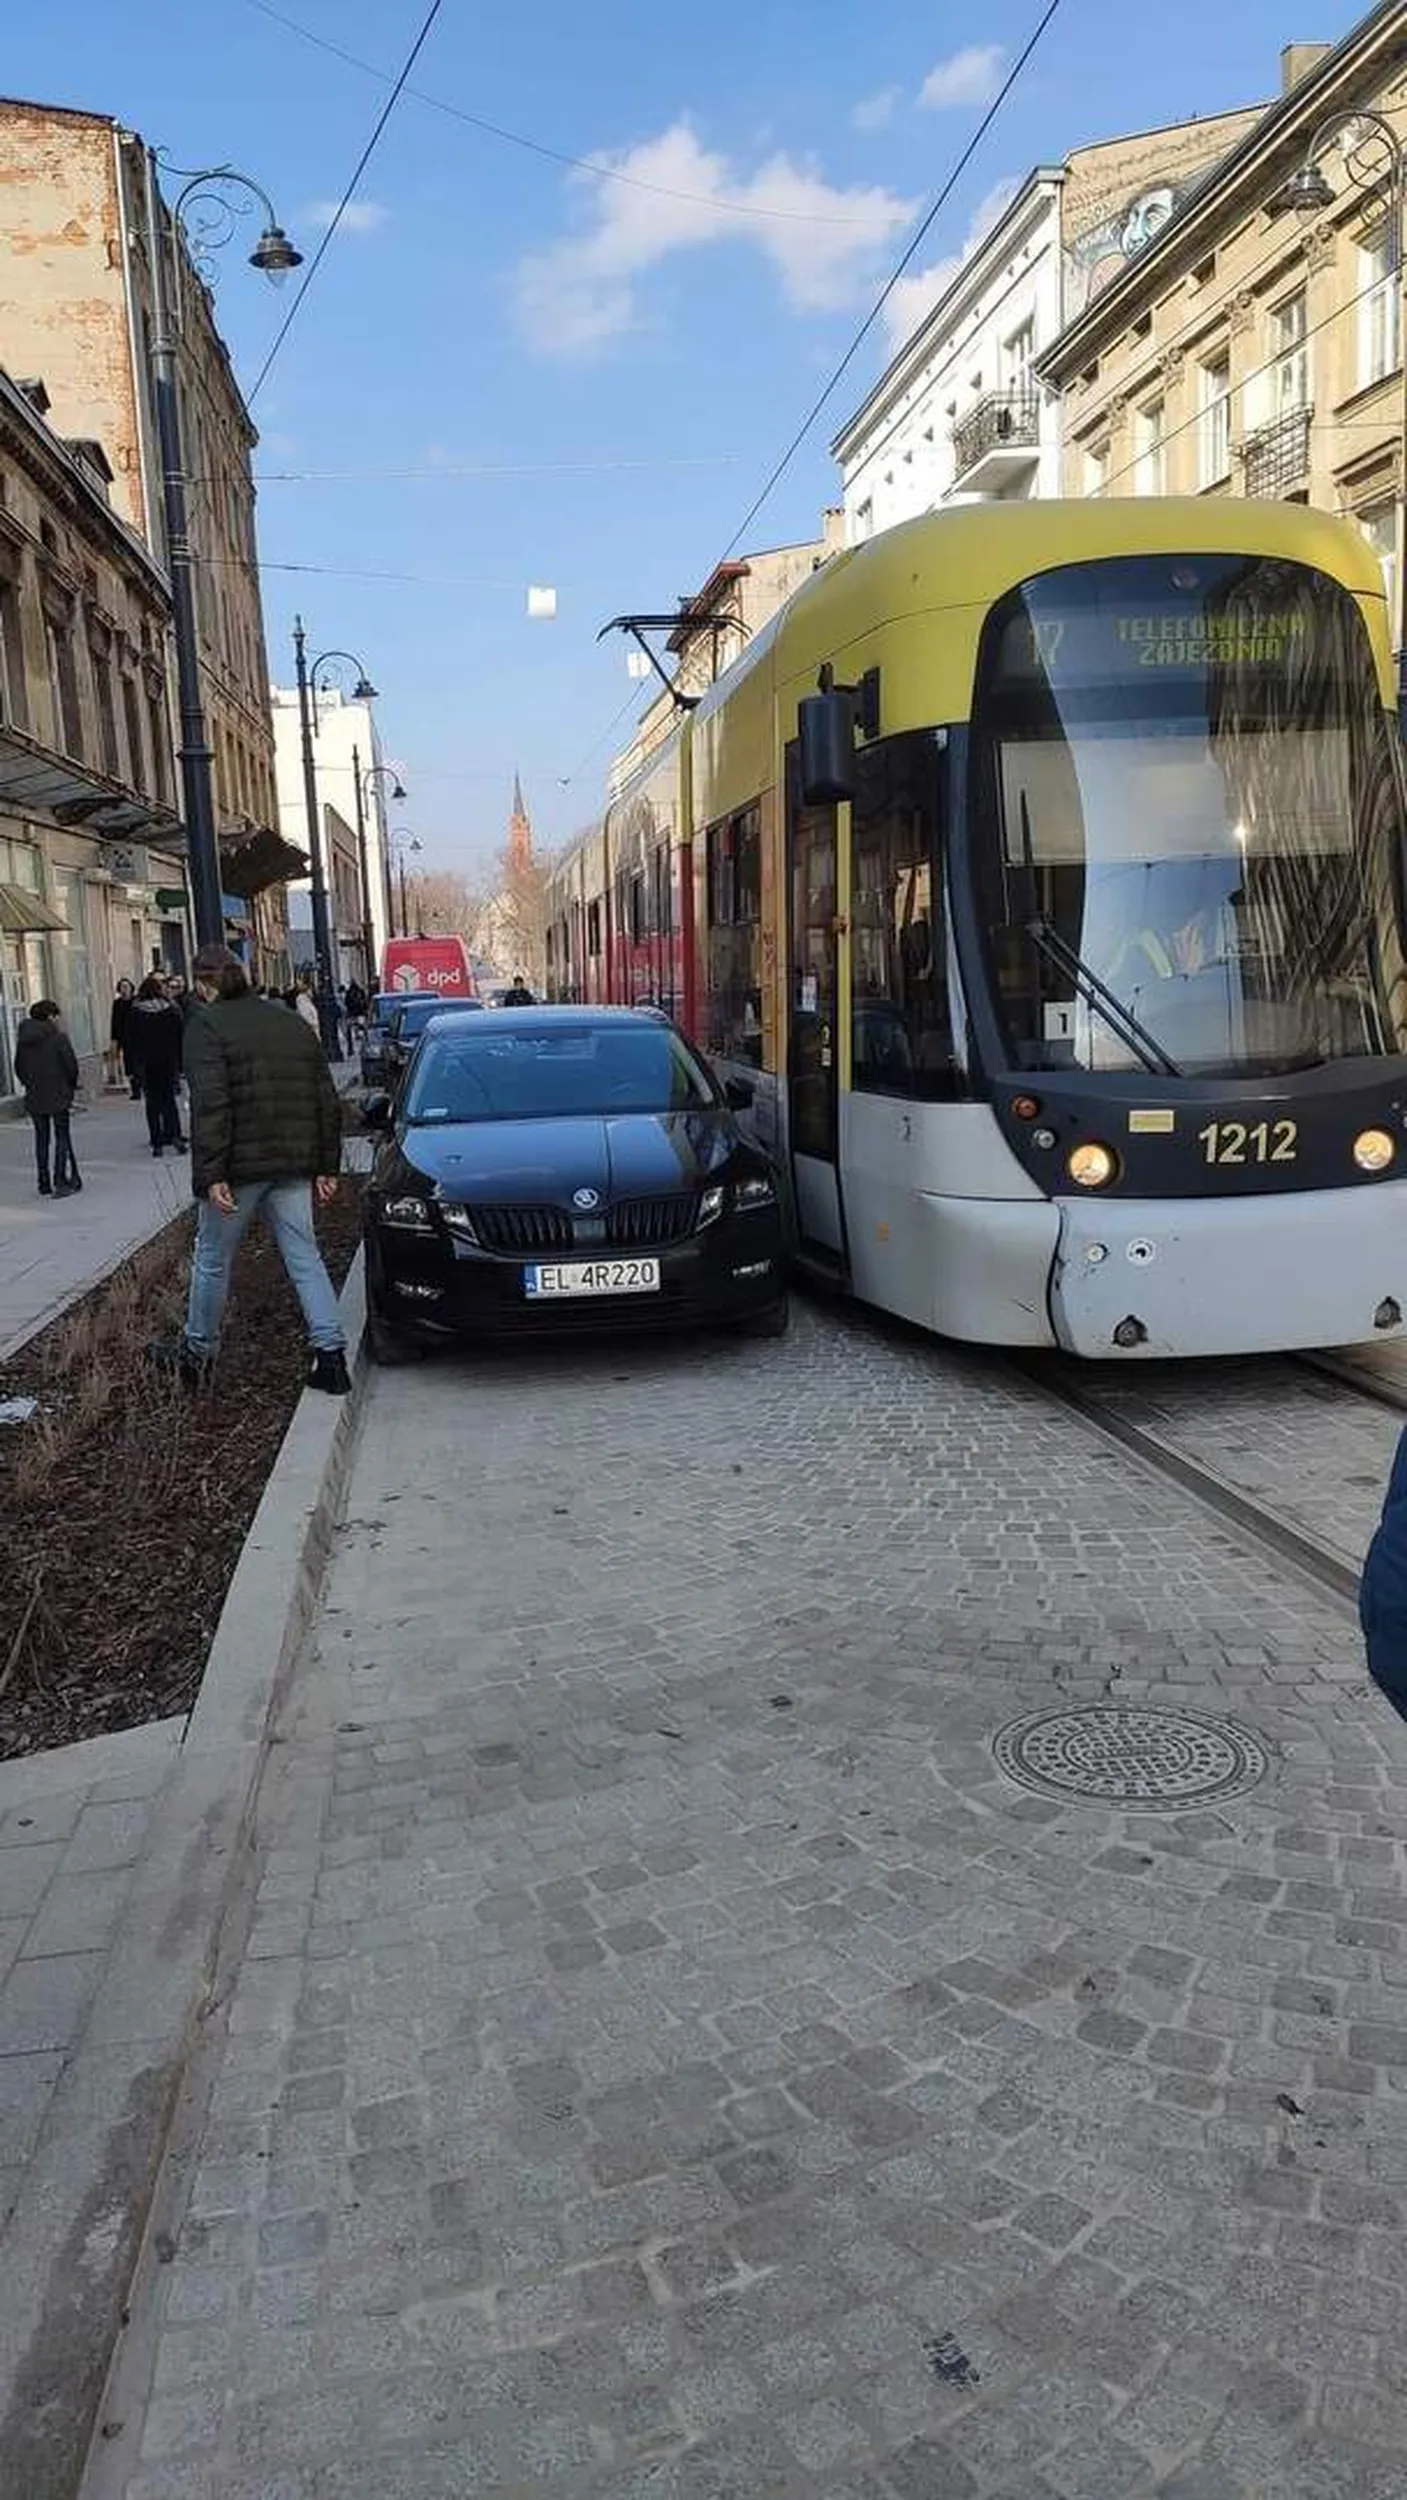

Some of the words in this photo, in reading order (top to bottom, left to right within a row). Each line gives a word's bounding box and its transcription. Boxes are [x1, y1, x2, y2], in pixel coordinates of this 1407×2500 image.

[1114, 612, 1307, 642] TELEFONICZNA
[1139, 638, 1282, 666] ZAJEZDNIA
[427, 967, 461, 988] dpd
[1199, 1120, 1297, 1163] 1212
[541, 1267, 570, 1291] EL
[581, 1261, 654, 1288] 4R220
